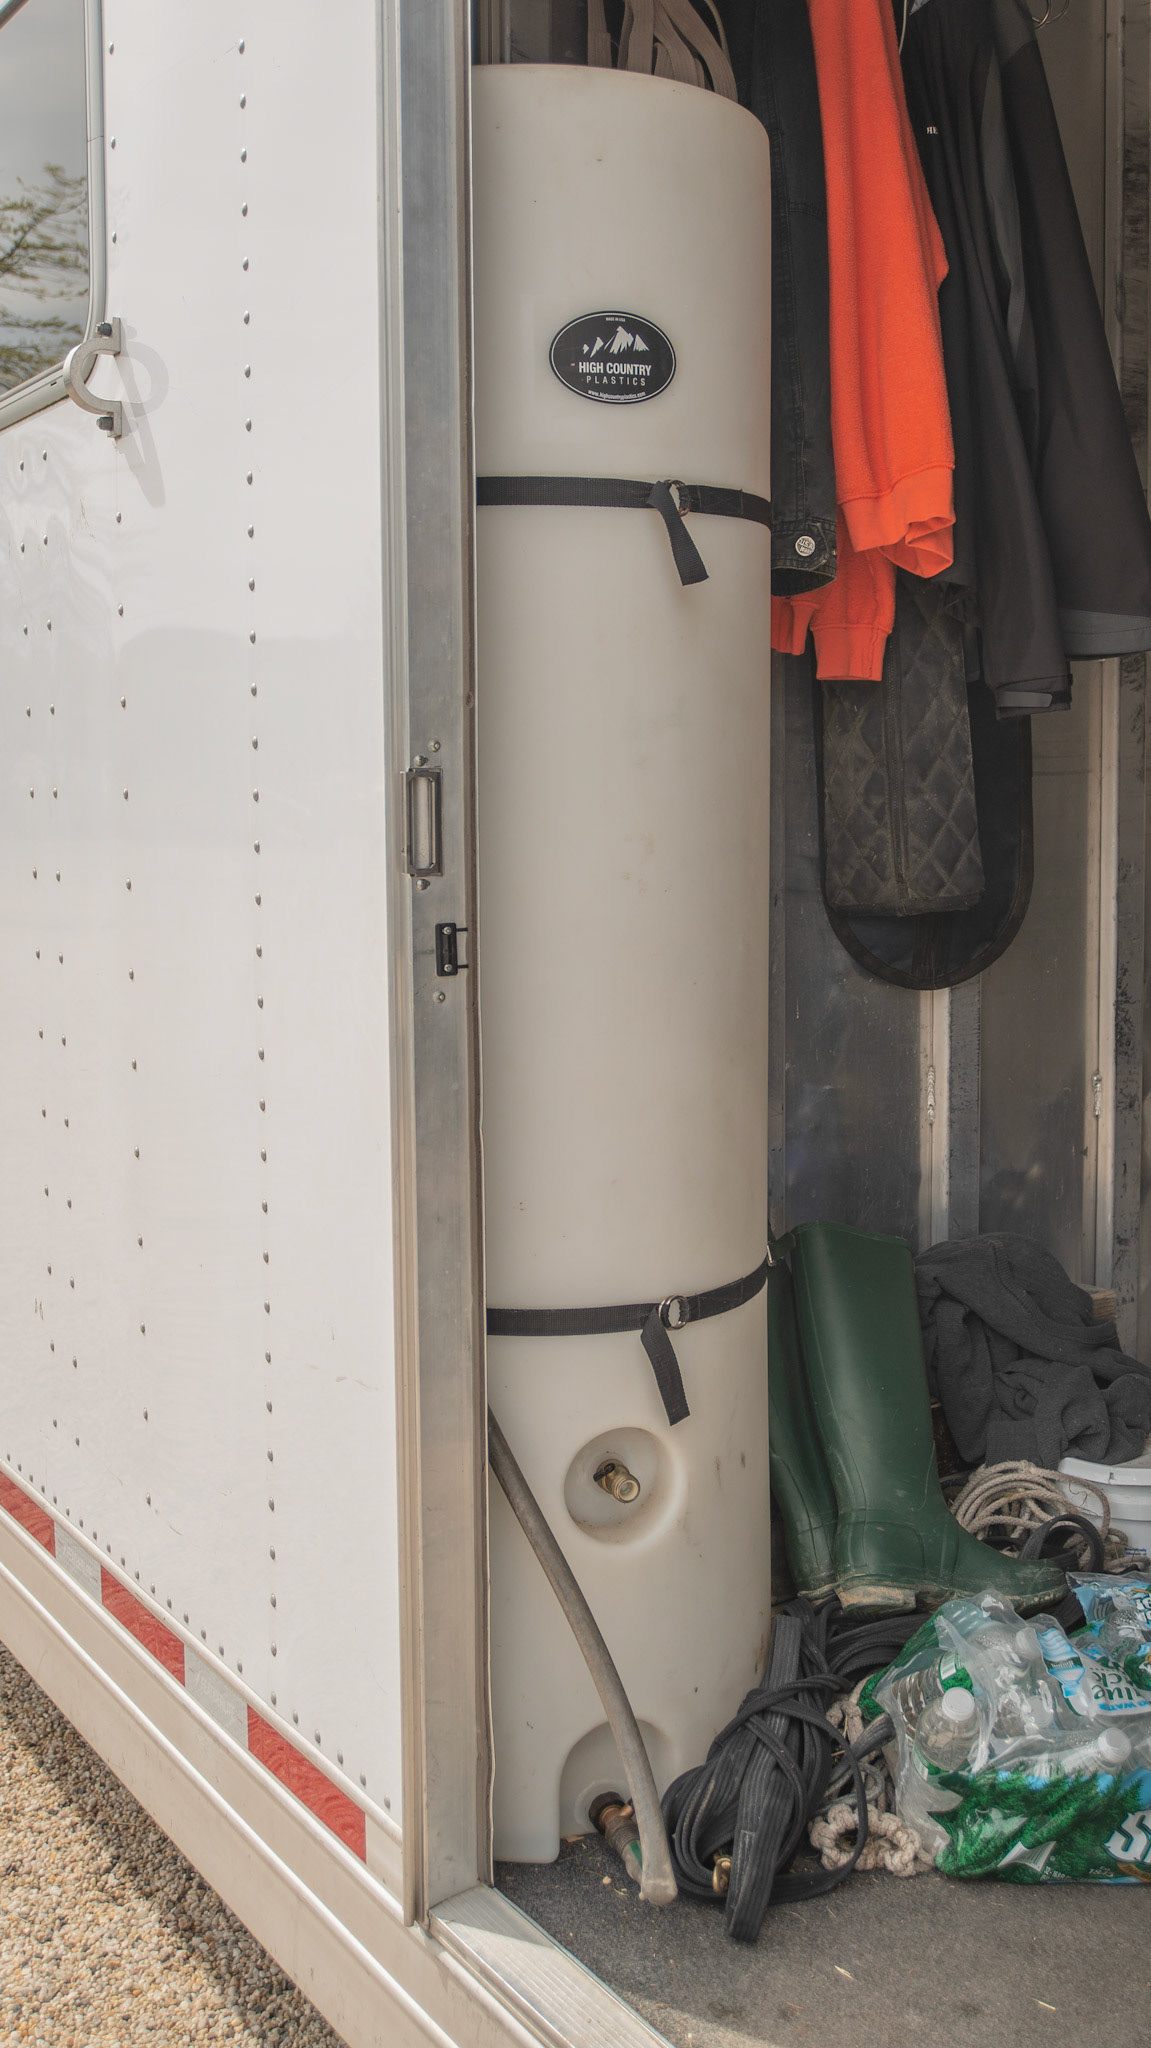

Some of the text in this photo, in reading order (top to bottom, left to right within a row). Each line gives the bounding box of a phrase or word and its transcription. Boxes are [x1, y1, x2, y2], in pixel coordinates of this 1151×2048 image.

[578, 361, 652, 376] HIGH COUNTRY
[586, 375, 647, 387] PLASTICS
[587, 389, 647, 401] www.highcountryplastics.com
